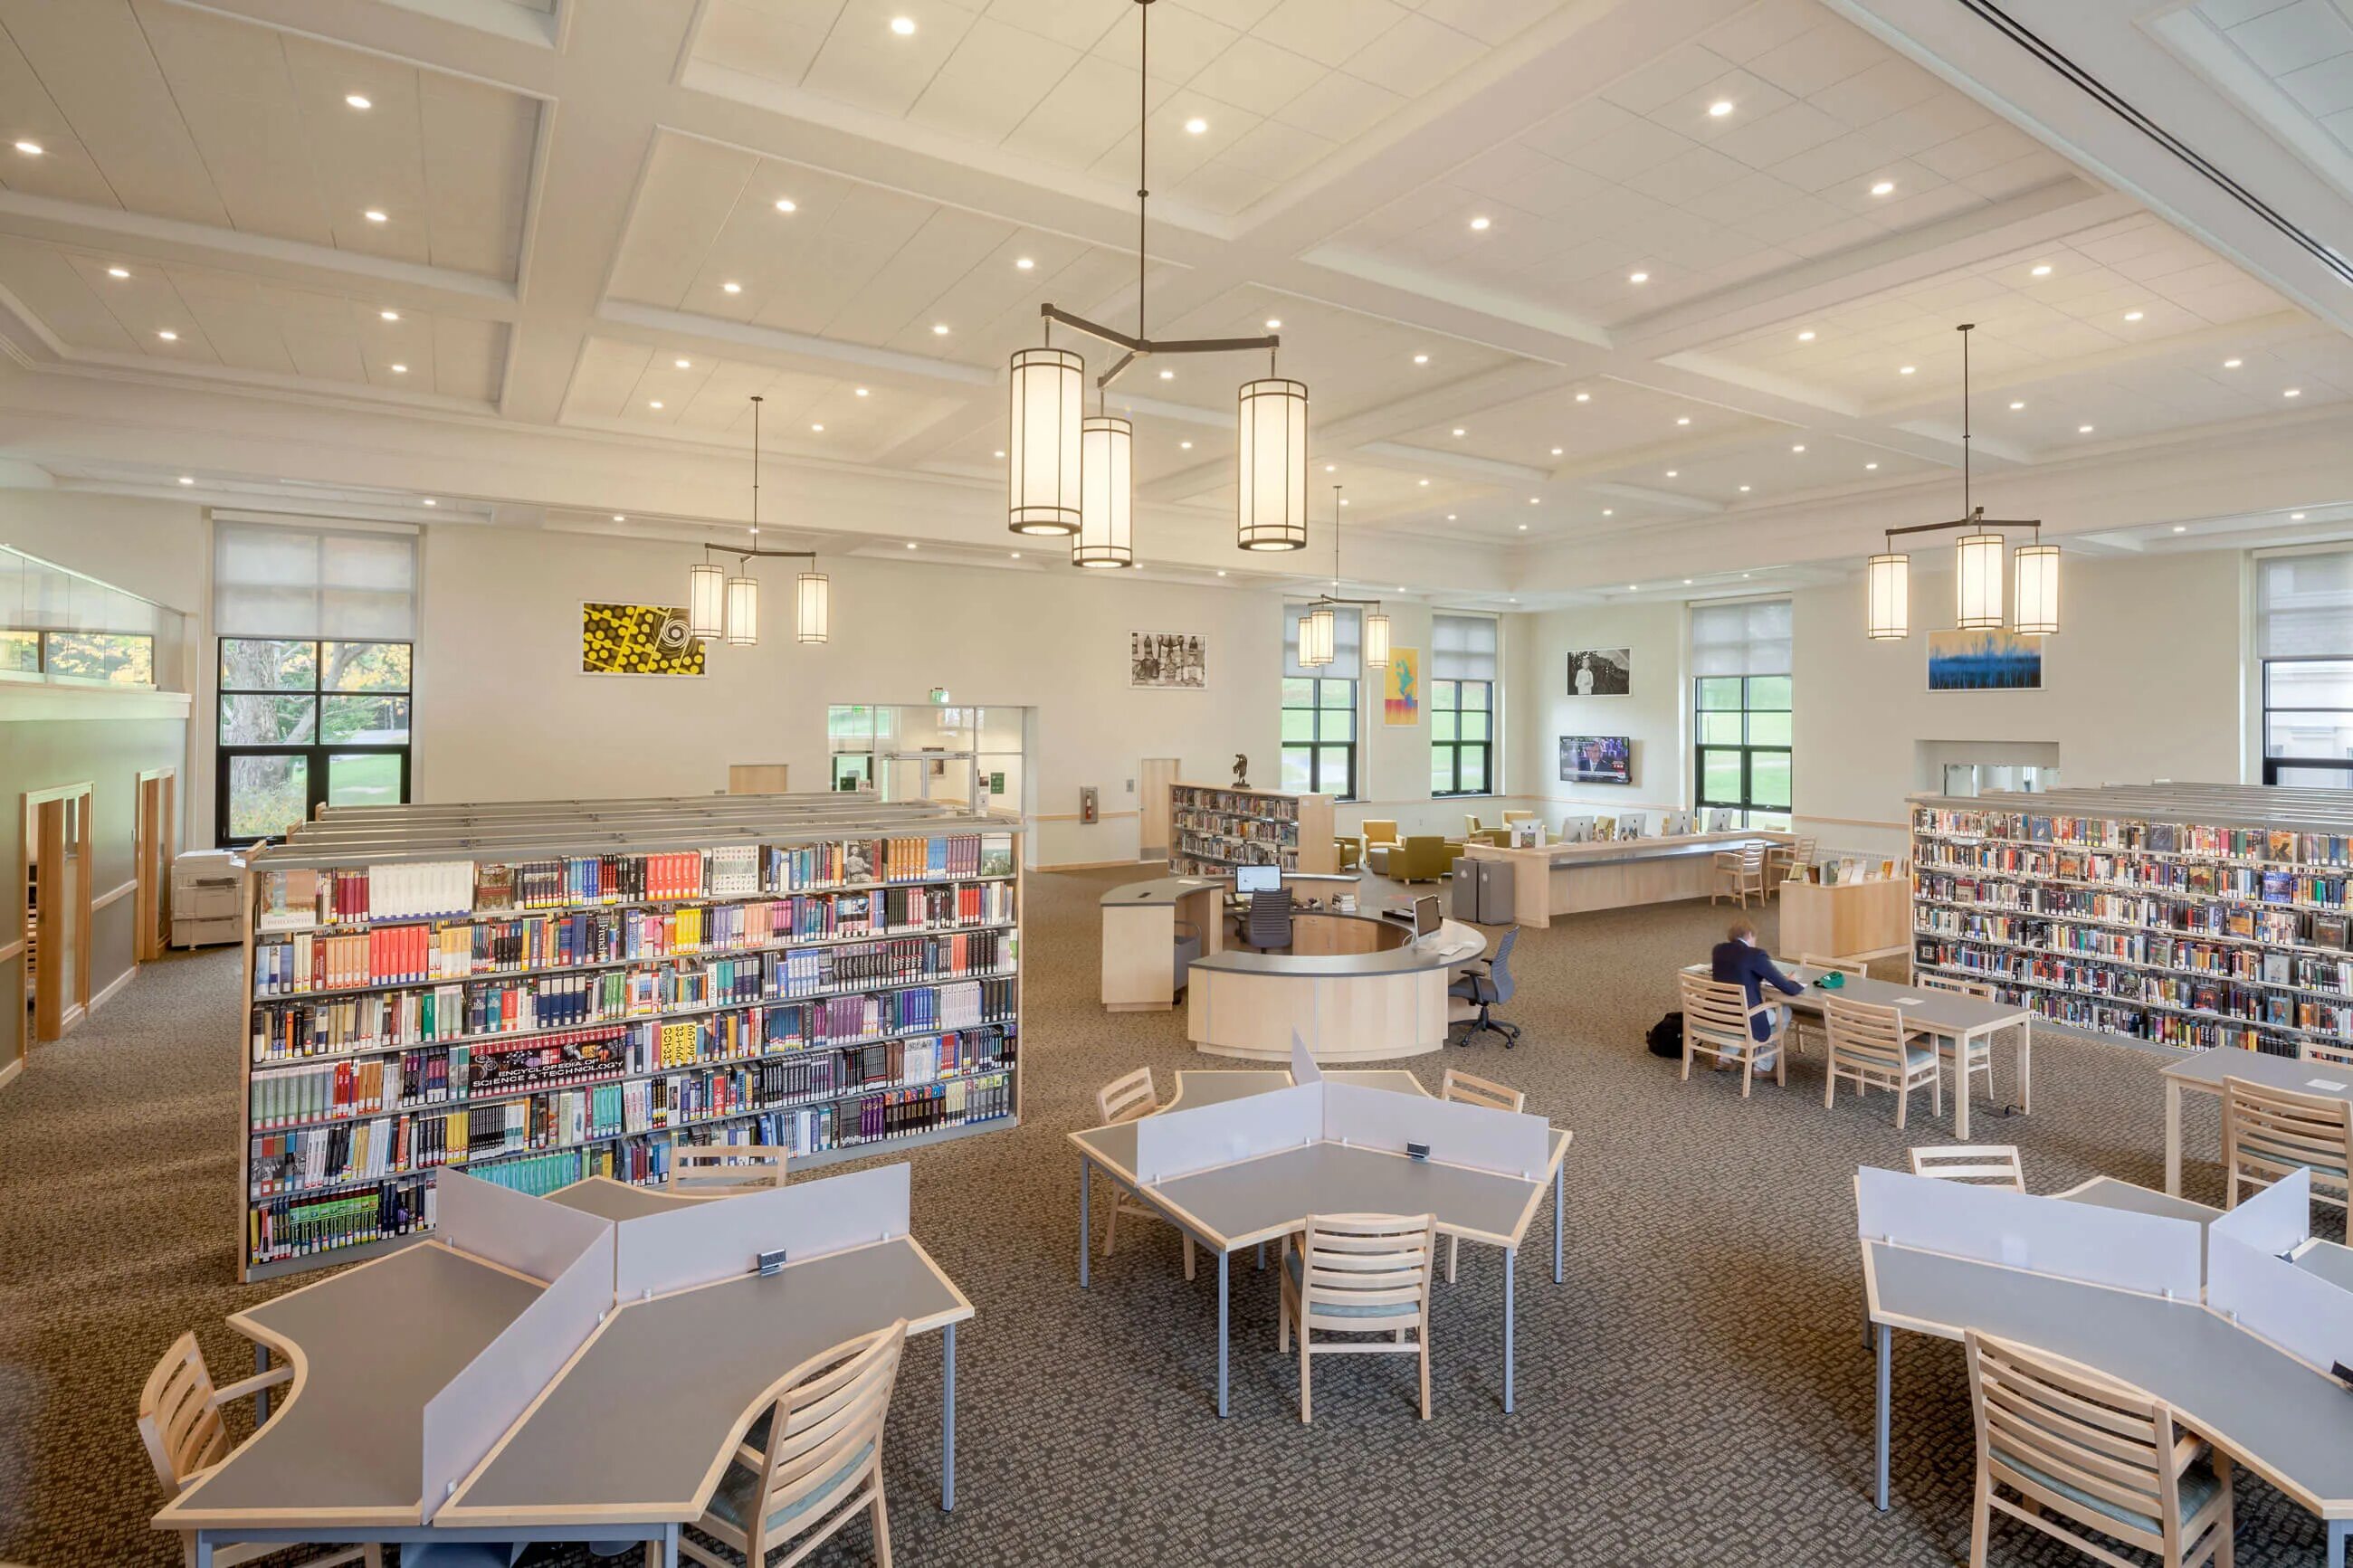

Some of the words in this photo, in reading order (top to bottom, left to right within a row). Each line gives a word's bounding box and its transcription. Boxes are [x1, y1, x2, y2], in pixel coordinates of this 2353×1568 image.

[472, 1075, 525, 1088] SCIENCE
[541, 1060, 624, 1078] TECHNOLOGY
[499, 1060, 584, 1078] ENCYCLOPEDIA
